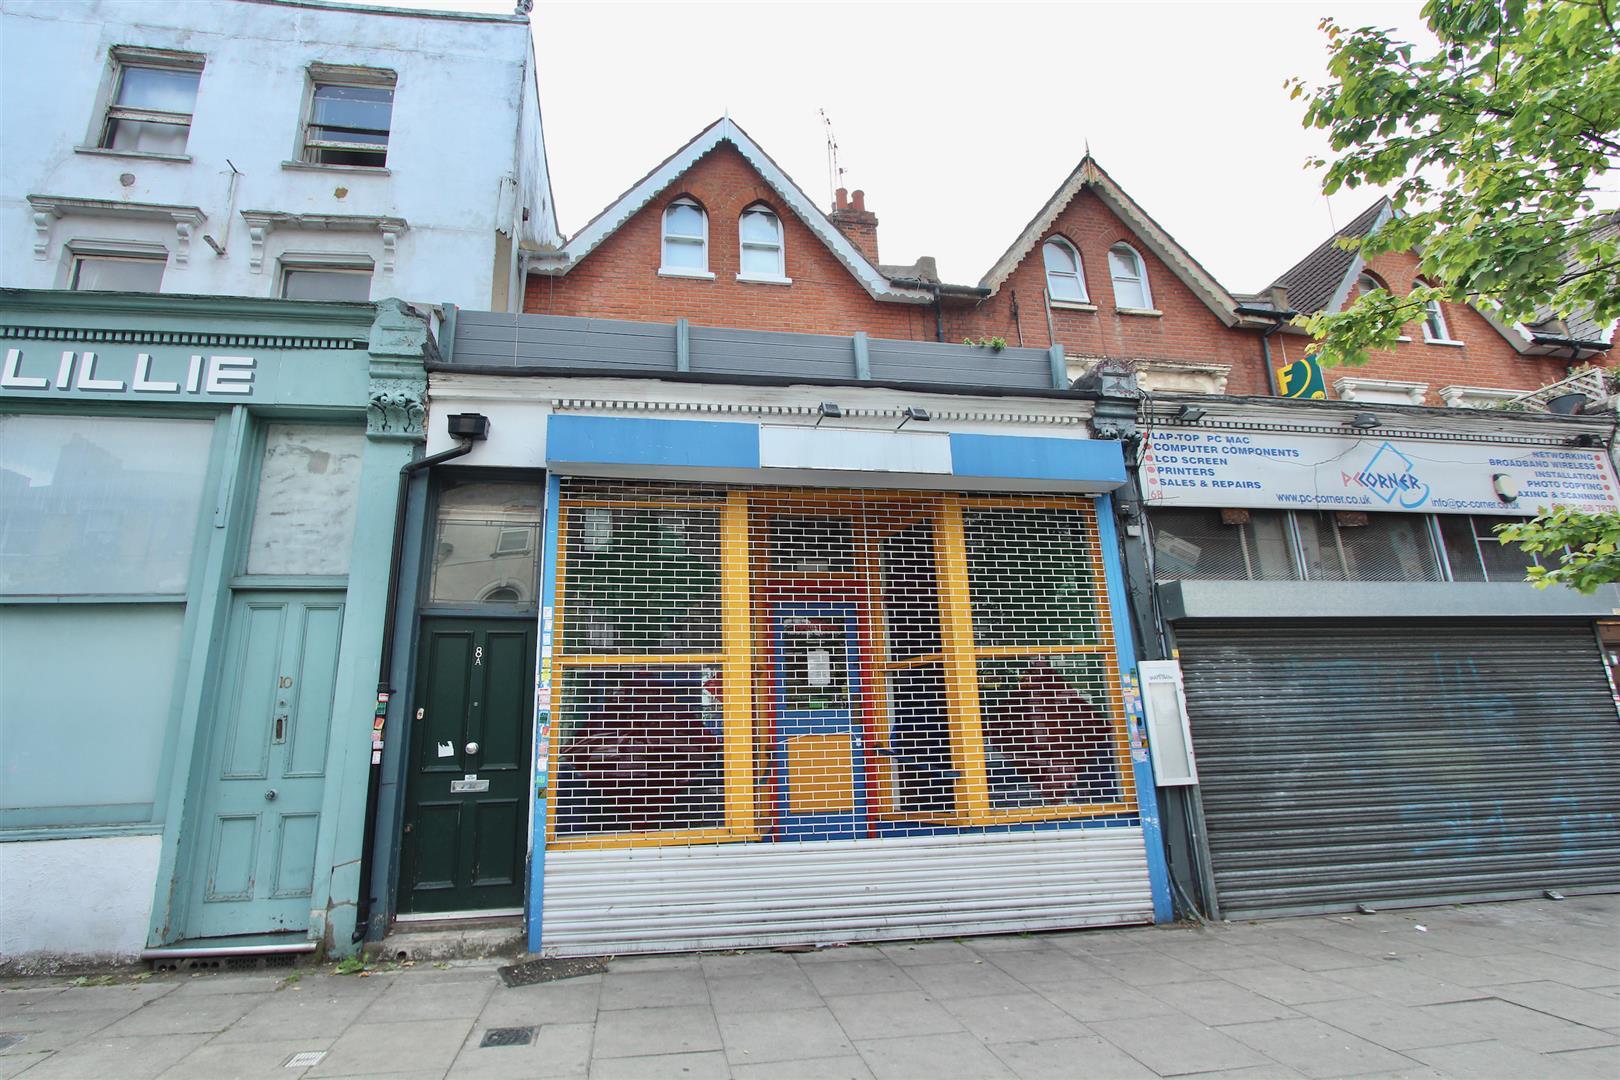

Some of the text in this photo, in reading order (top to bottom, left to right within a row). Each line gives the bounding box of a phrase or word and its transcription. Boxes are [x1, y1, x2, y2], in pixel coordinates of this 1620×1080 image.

[1, 349, 257, 396] LILLIE
[1151, 432, 1250, 445] LAP-TOP PC MAC
[1153, 442, 1300, 458] COMPUTER COMPONENTS
[1531, 451, 1594, 461] NETWORKING
[1155, 454, 1228, 466] LCD SCREEN
[1489, 458, 1596, 471] BROADBAND WIRELESS
[1157, 466, 1216, 477] PRINTERS
[1534, 470, 1601, 481] INSTALLATION
[1159, 478, 1261, 489] SALES & REPAIRS
[1526, 480, 1603, 491] PHOTO COPYING
[1276, 493, 1372, 505] www.pc-corner.co.uk
[1516, 490, 1607, 500] AXING & SCANNING
[475, 646, 483, 658] 8
[474, 657, 482, 666] A
[278, 675, 293, 689] 10
